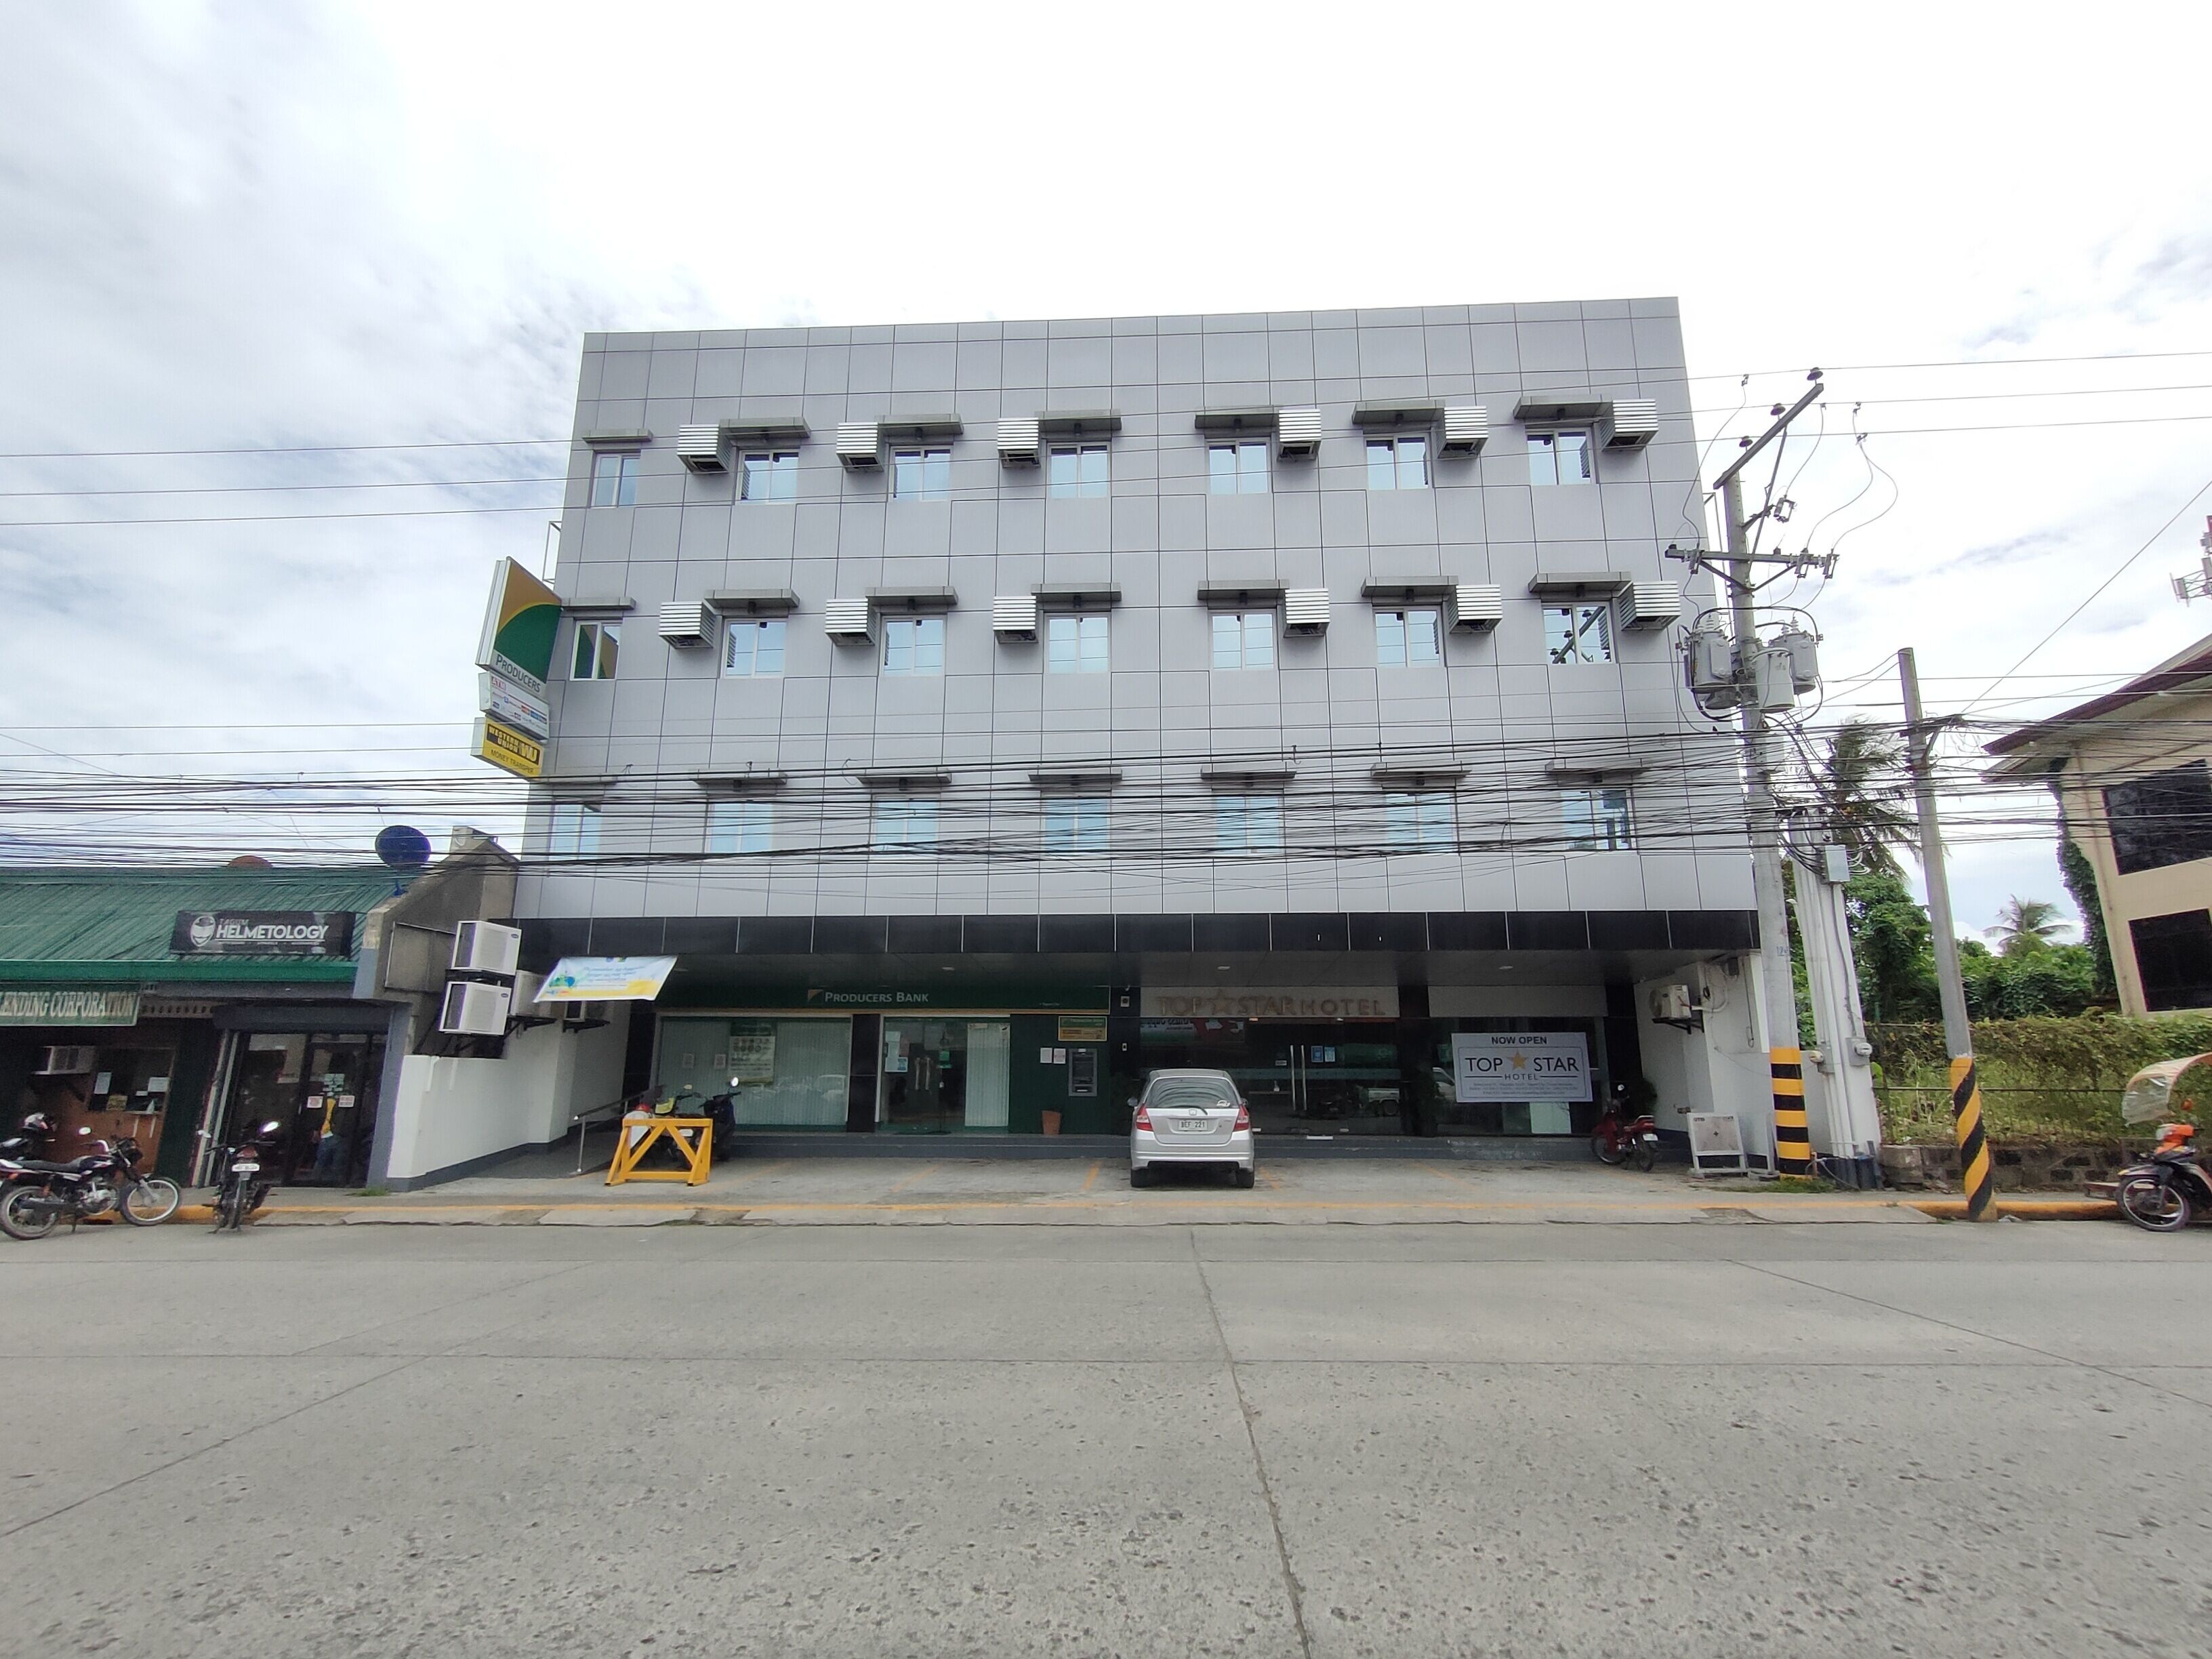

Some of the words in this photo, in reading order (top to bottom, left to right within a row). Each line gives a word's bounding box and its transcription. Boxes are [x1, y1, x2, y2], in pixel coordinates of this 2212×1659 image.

[496, 654, 541, 693] PRODUCERS
[489, 726, 518, 745] WESTERN
[497, 737, 518, 753] UNION
[216, 925, 329, 939] HELMETOLOGY
[50, 991, 136, 1017] CORPORATION
[825, 992, 892, 1002] PRODUCERS
[896, 991, 929, 1002] BANK
[1156, 996, 1202, 1016] TOP
[1237, 996, 1292, 1016] STAR
[1300, 998, 1386, 1017] HOTEL
[1518, 1036, 1547, 1044] OPEN
[1465, 1057, 1503, 1072] TOP
[1533, 1057, 1579, 1072] STAR
